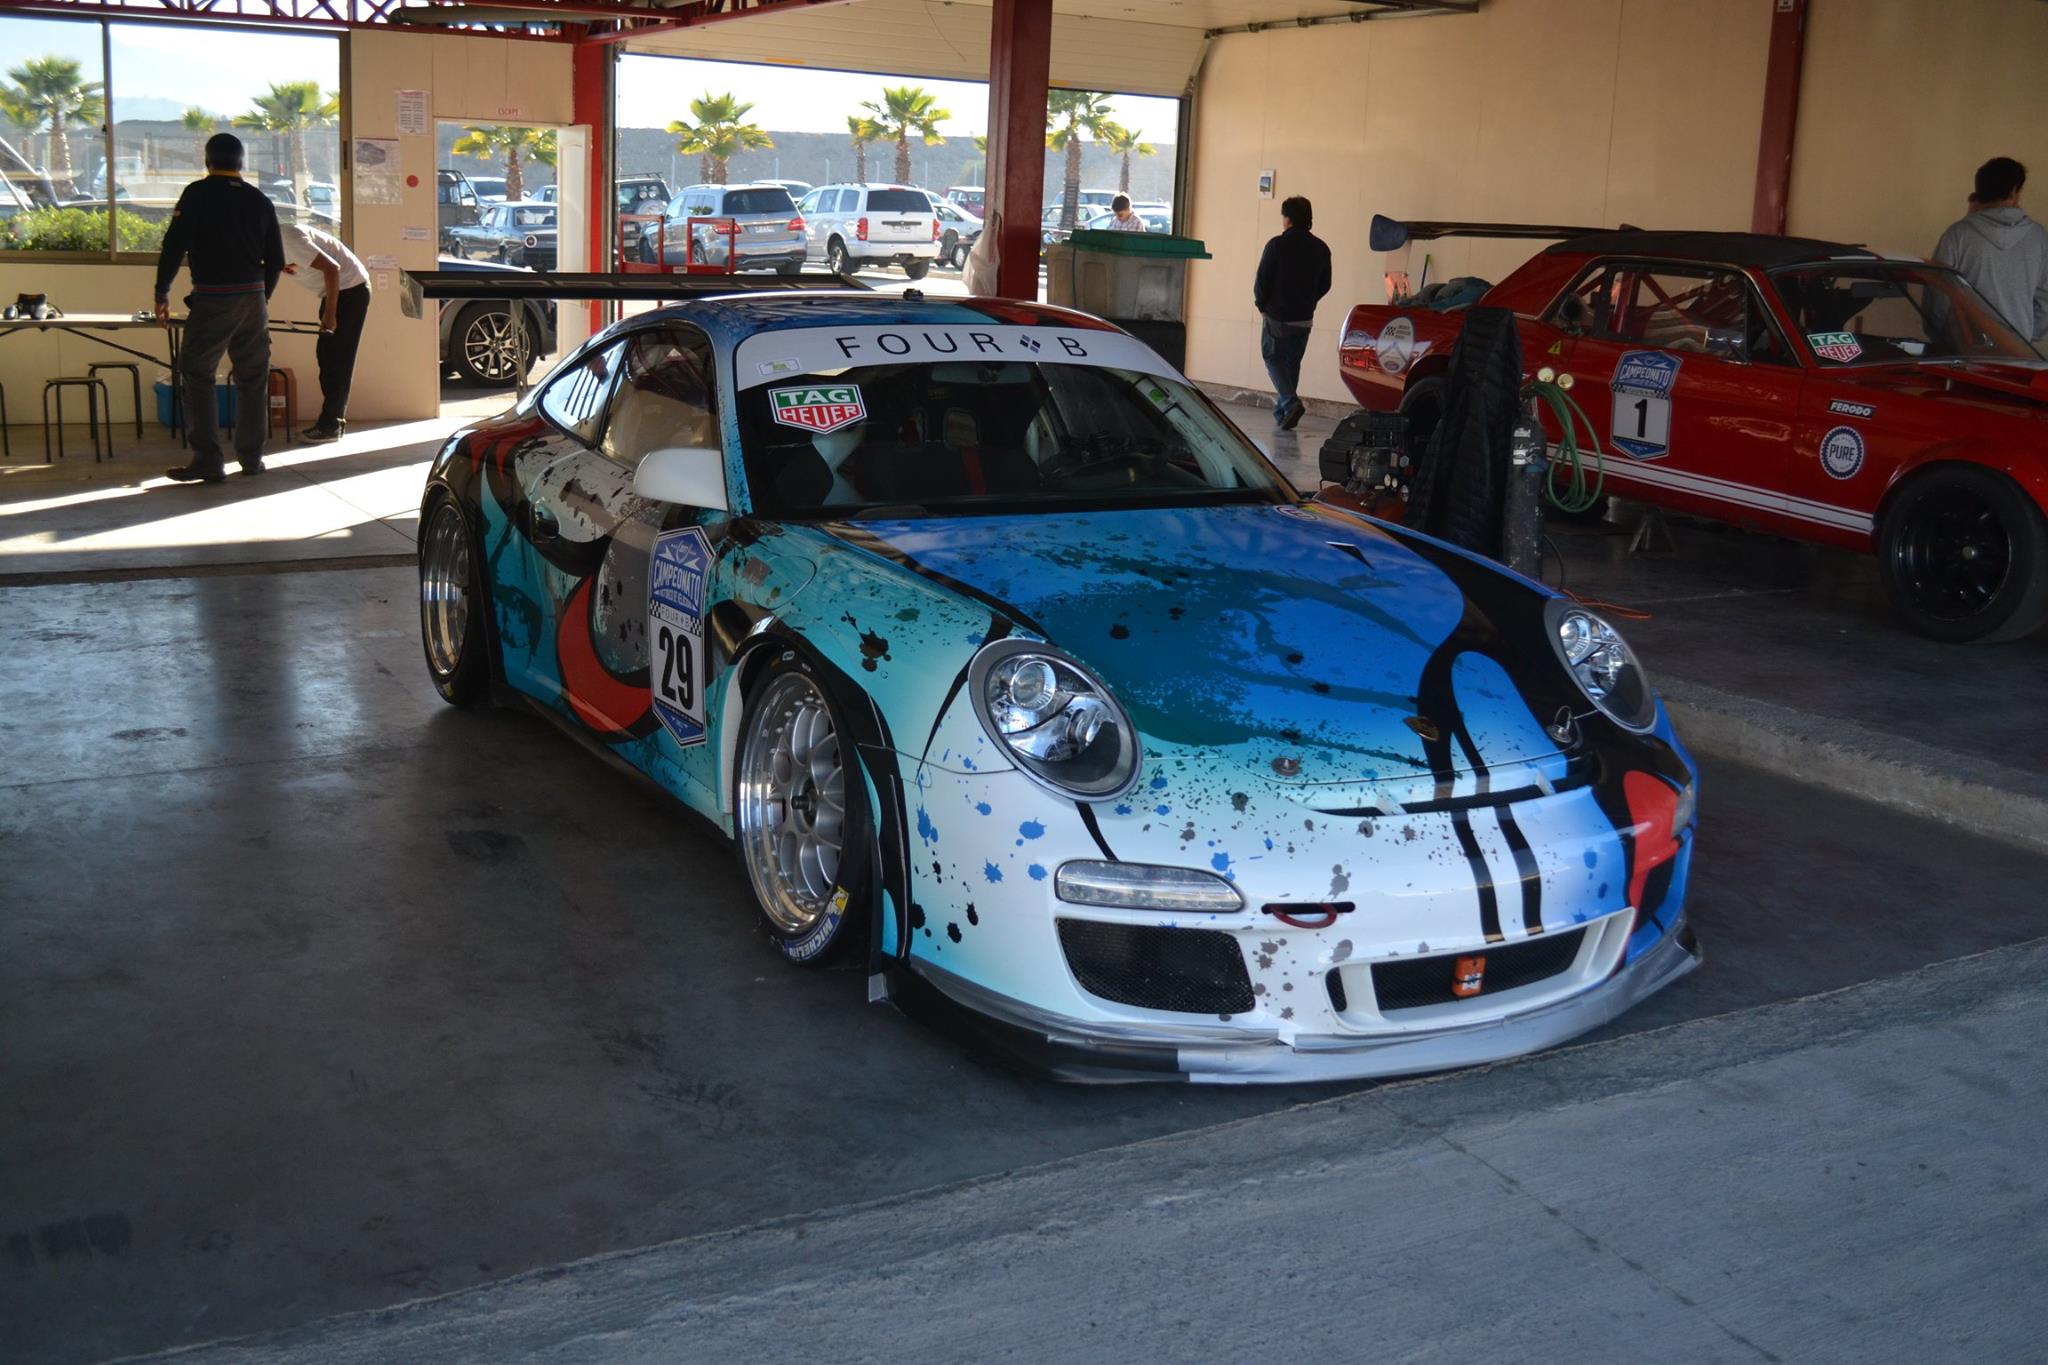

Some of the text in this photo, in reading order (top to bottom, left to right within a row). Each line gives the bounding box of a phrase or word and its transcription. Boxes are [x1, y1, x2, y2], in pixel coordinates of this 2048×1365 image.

[835, 332, 1088, 359] FOUR B
[1812, 334, 1853, 346] TAG
[1816, 345, 1860, 361] HEUER
[1619, 364, 1671, 386] CAMPEONATO
[780, 389, 852, 405] TAG
[781, 405, 858, 428] HEUER
[1634, 398, 1648, 438] 1
[1829, 401, 1872, 416] FERODO
[1828, 444, 1855, 462] PURE
[653, 559, 702, 607] CAMPEONATO
[658, 625, 694, 711] 29
[788, 917, 834, 958] MICHELIN
